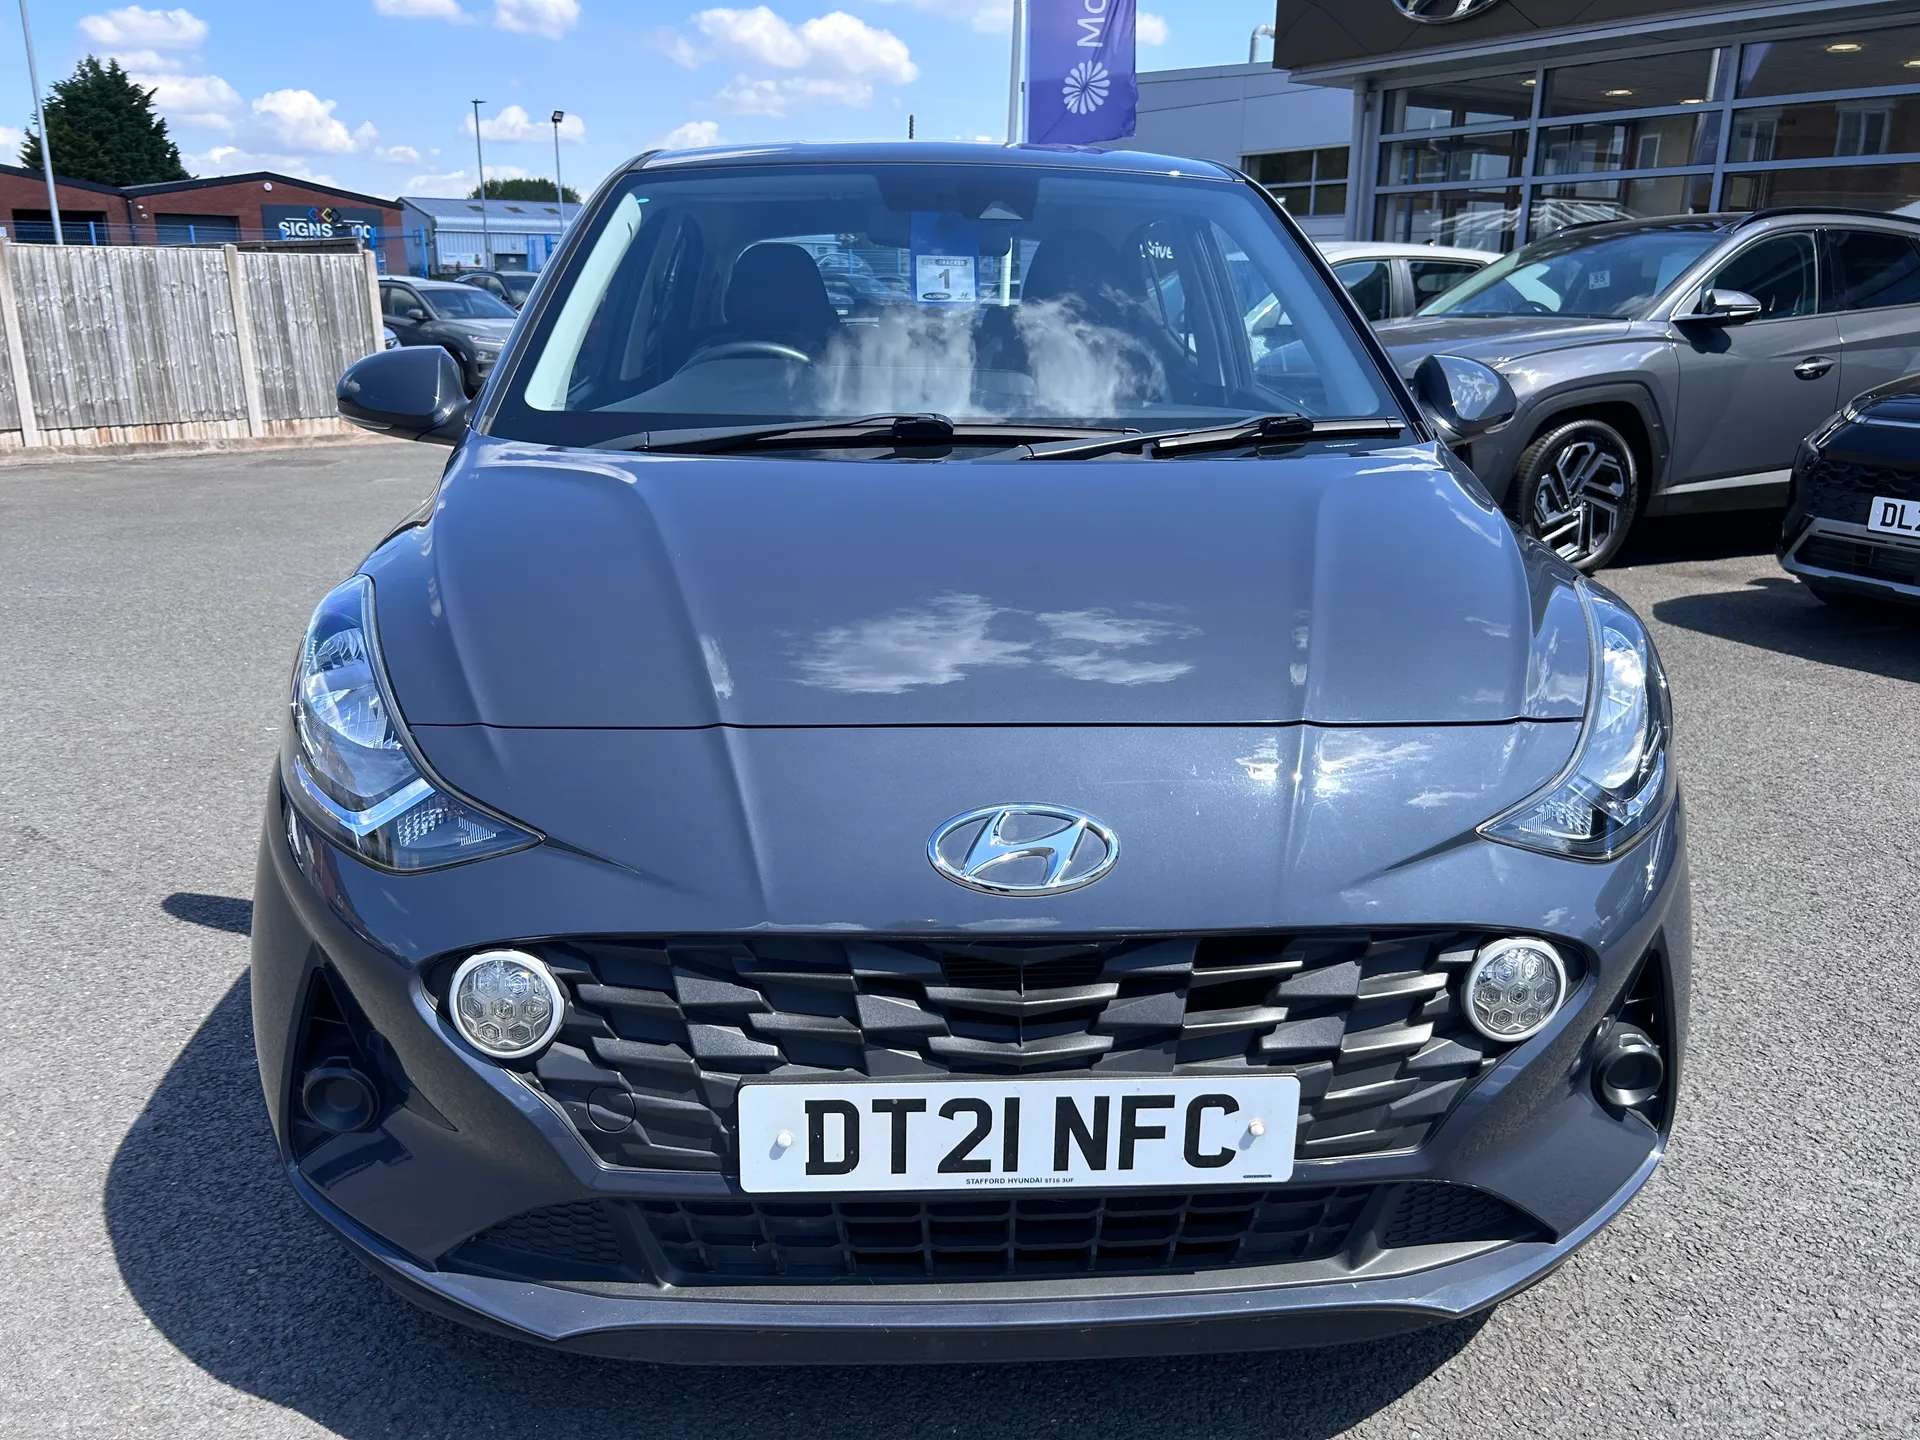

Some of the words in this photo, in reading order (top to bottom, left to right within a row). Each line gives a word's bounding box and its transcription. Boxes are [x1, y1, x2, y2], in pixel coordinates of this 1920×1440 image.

[279, 221, 333, 237] SIGNS
[938, 269, 950, 289] 1
[804, 1095, 1019, 1176] DT21
[1053, 1093, 1240, 1172] NFC
[966, 1177, 1006, 1185] STAFFORD
[1007, 1176, 1043, 1184] HYUNDAI
